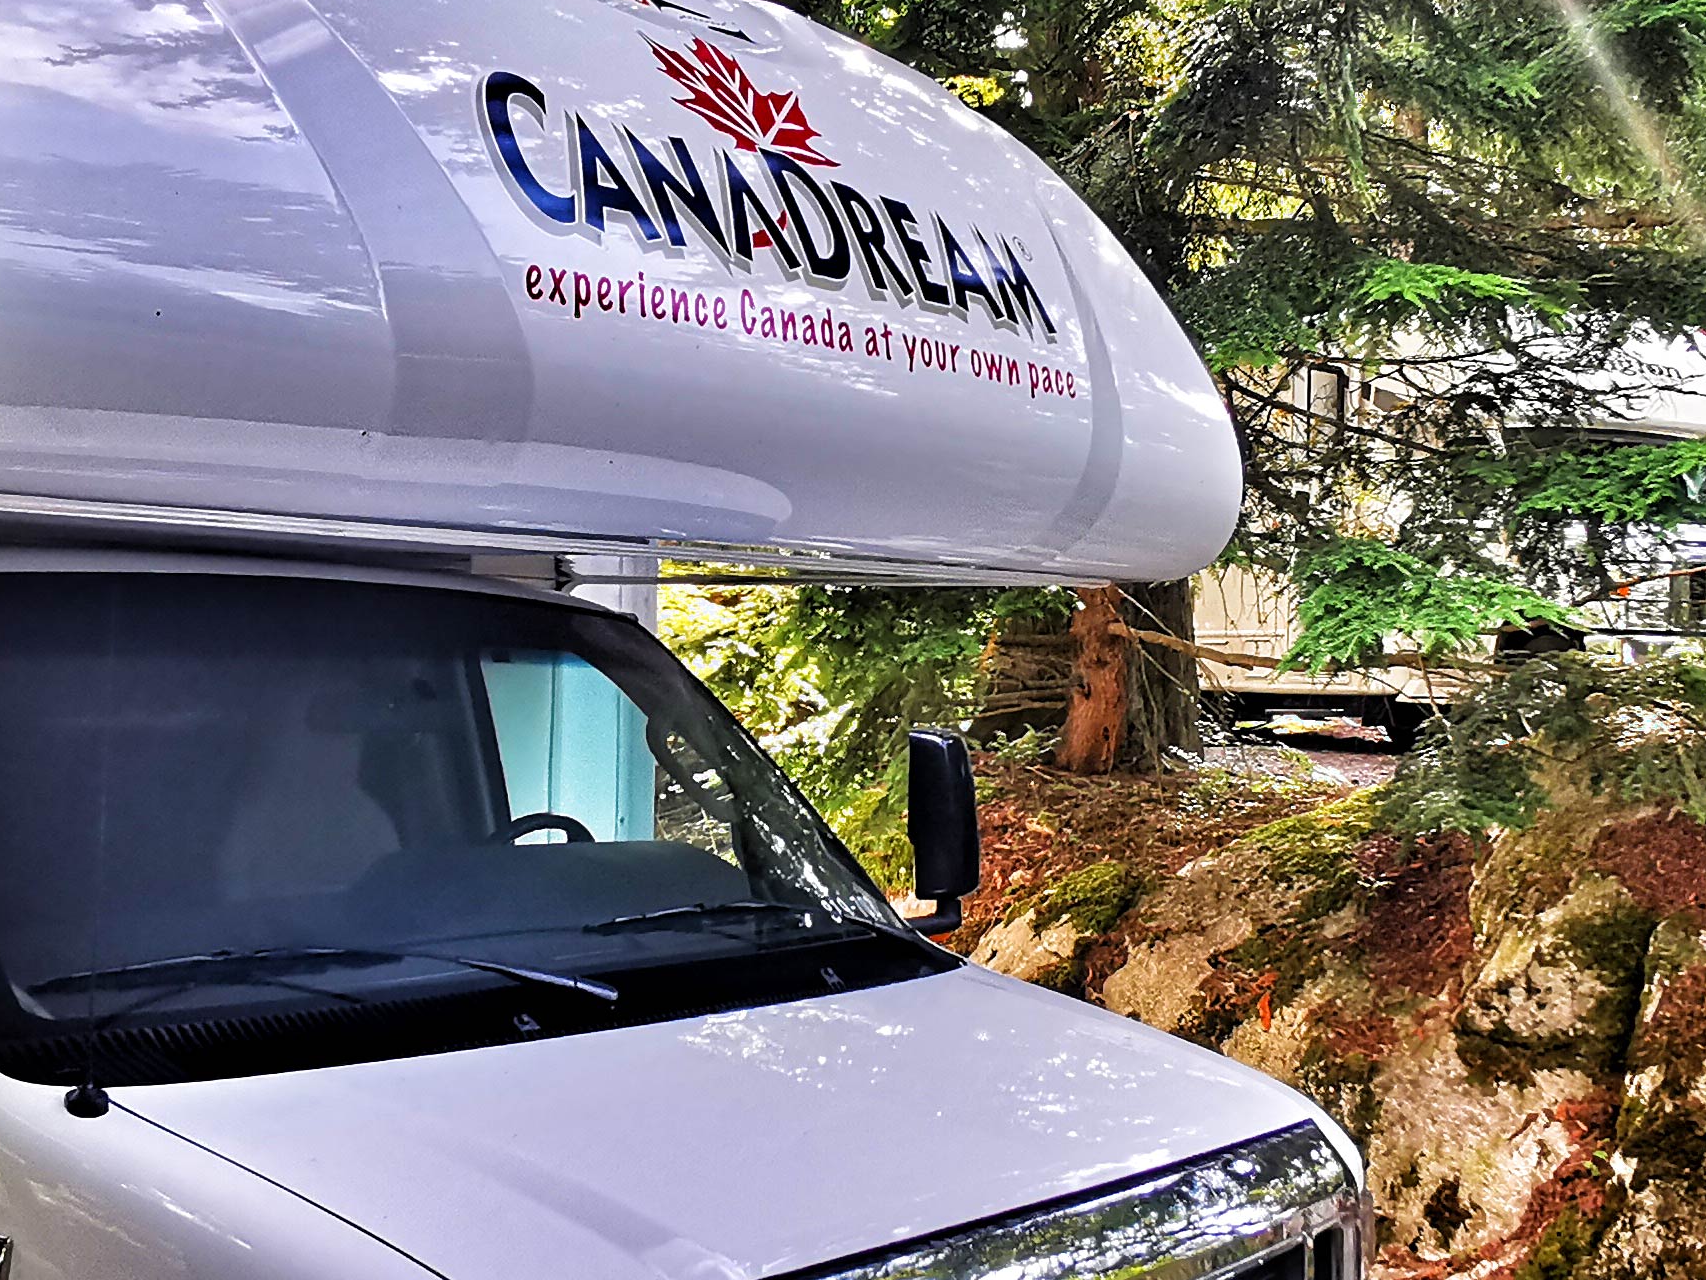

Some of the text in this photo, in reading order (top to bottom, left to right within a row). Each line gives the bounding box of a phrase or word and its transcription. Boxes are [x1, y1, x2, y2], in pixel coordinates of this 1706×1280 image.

[526, 265, 1077, 399] experience Canada at your own pace
